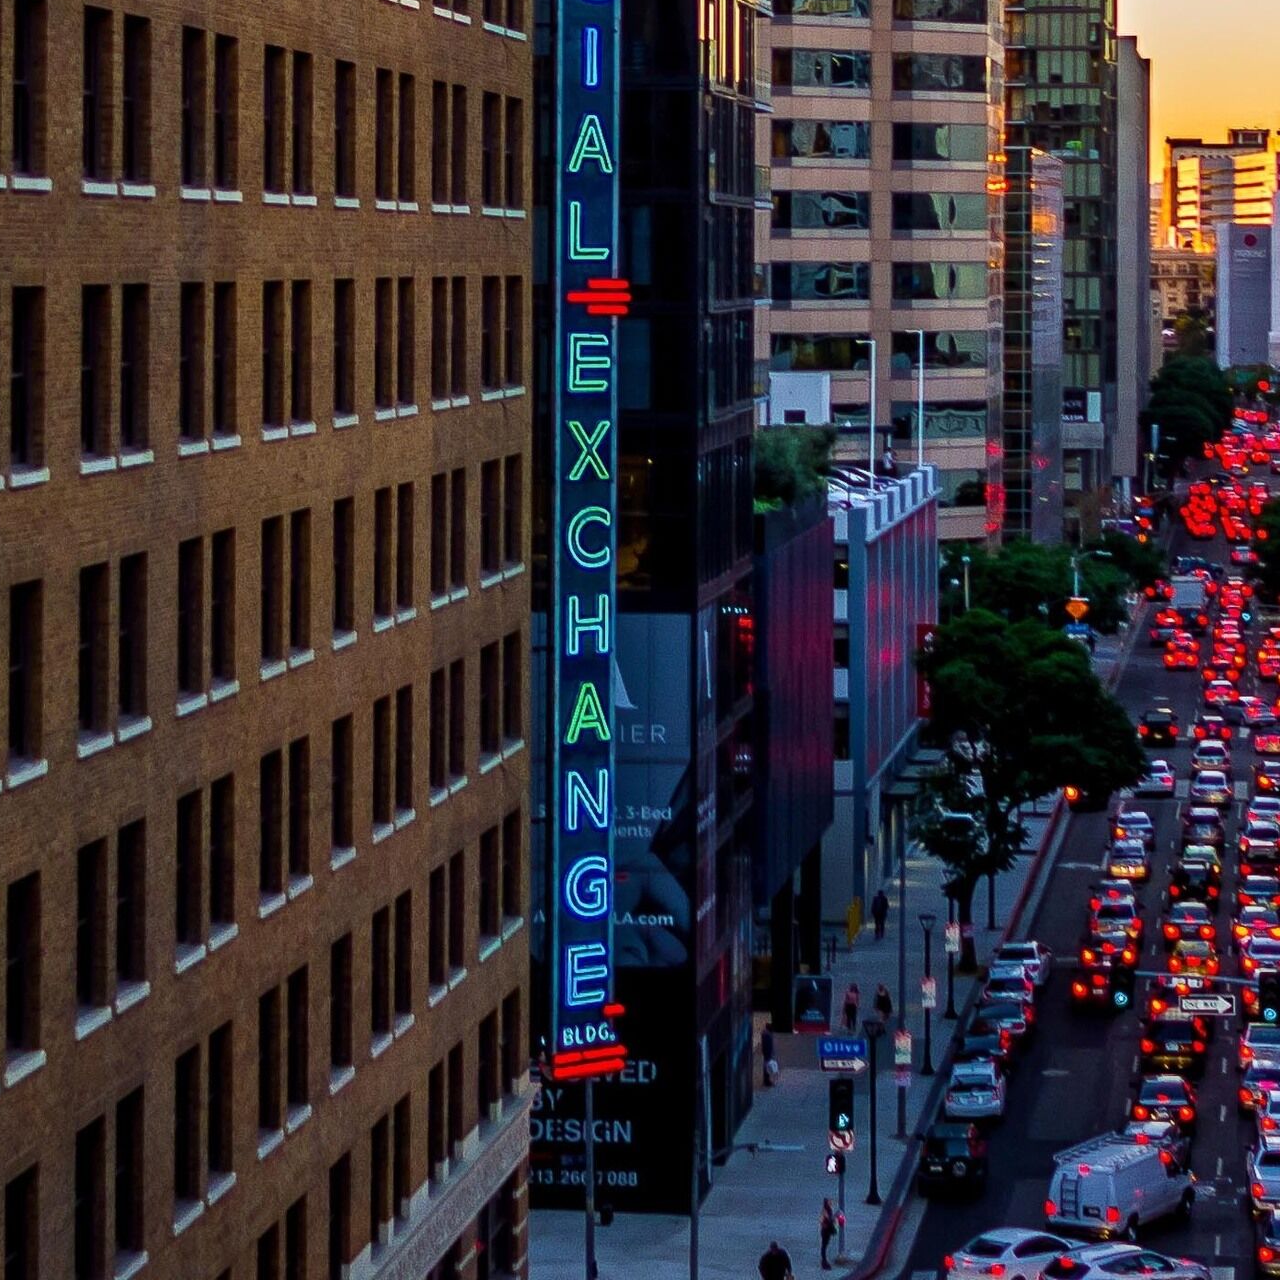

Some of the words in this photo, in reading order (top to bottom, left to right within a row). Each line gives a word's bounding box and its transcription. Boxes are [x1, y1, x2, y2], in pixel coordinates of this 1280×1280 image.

[565, 332, 611, 1005] EXCHANGE
[563, 1021, 616, 1047] BLDG.
[823, 1041, 860, 1054] Olive
